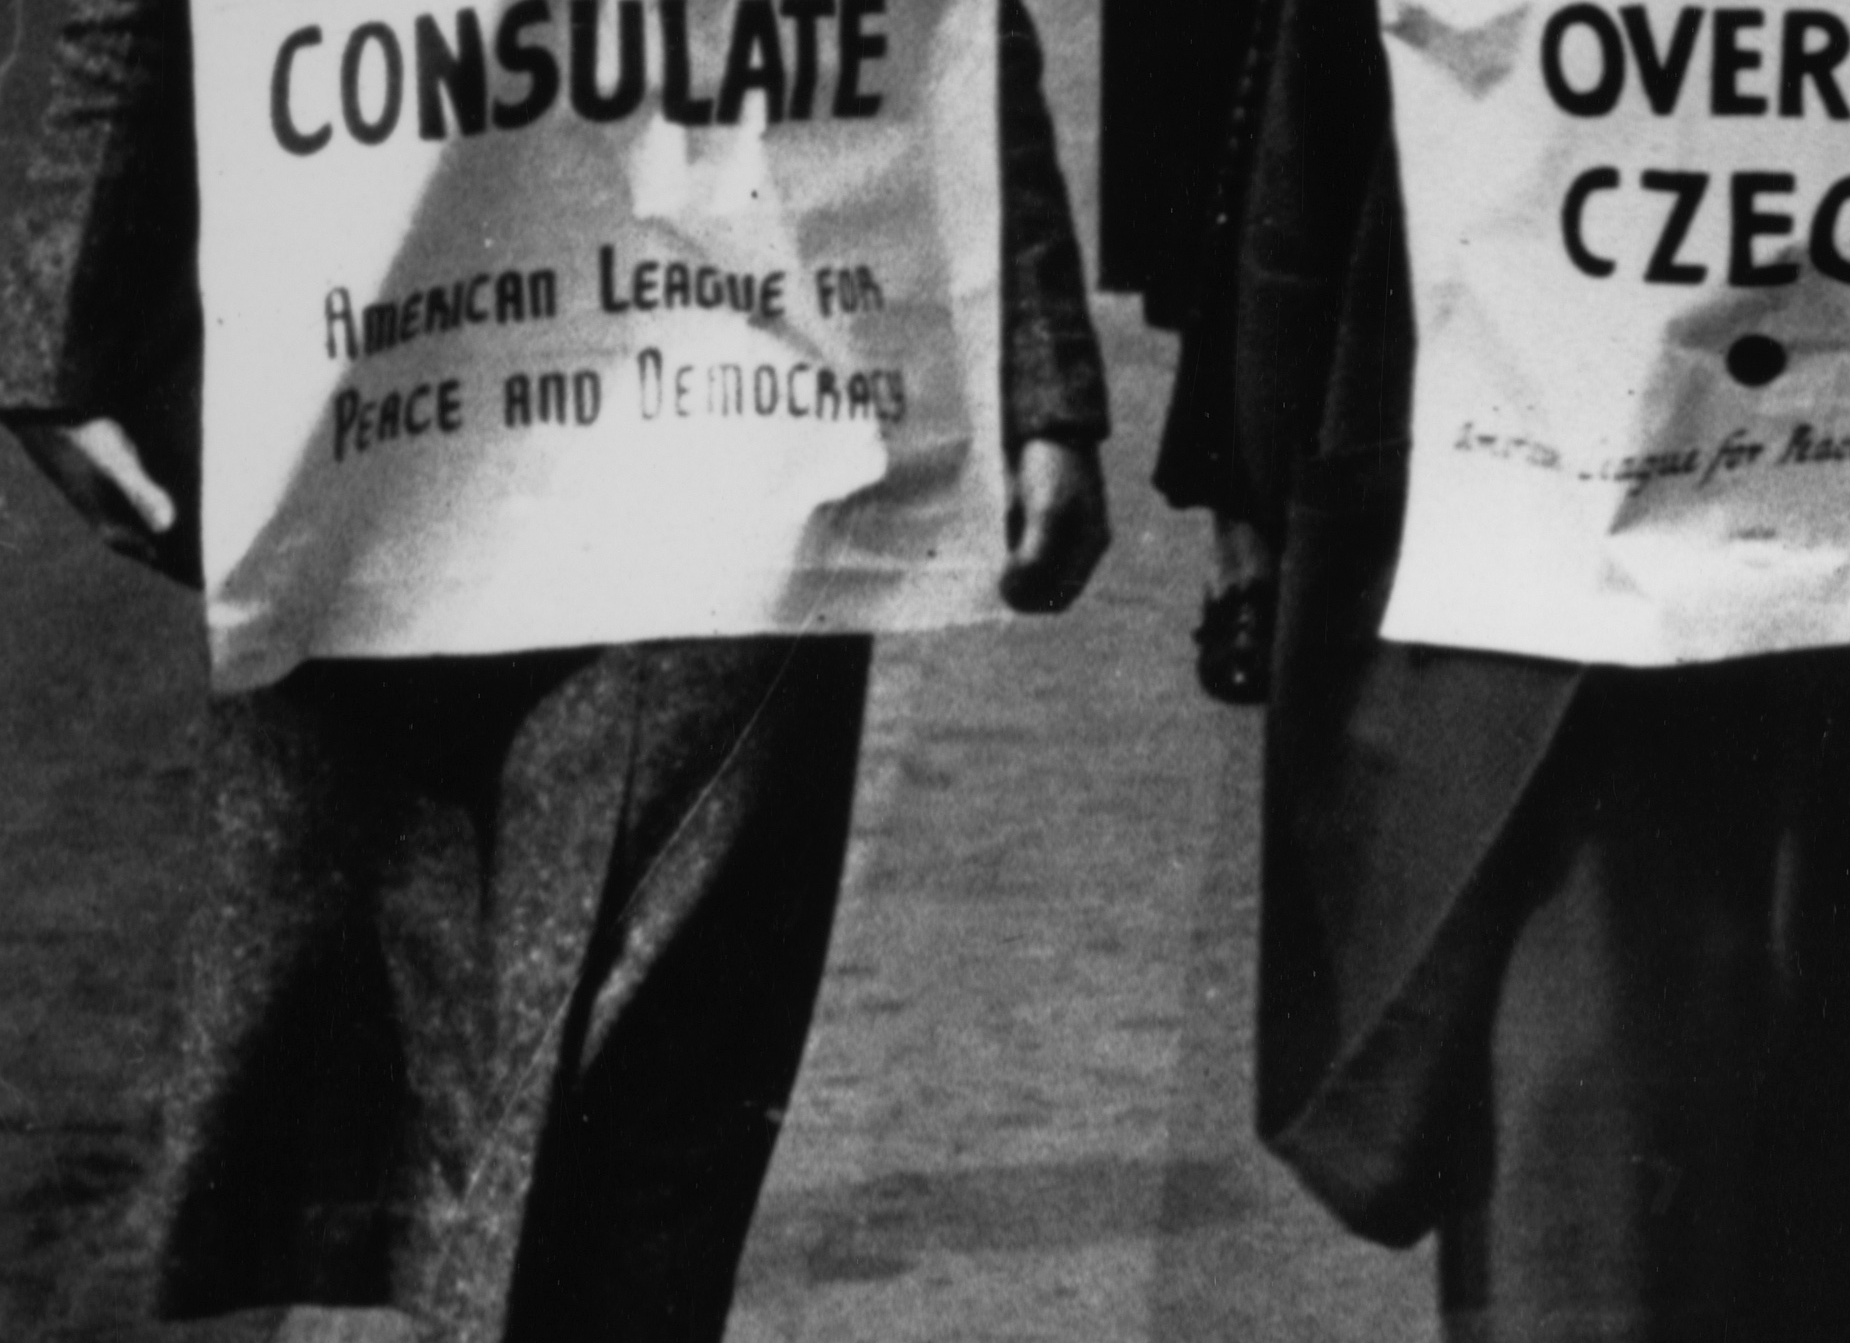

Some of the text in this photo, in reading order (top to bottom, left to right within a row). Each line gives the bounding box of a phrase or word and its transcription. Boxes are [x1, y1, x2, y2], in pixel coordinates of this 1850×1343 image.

[599, 244, 786, 318] LEAGUE
[814, 264, 886, 319] FOR
[331, 379, 463, 463] PEACE
[503, 369, 602, 430] AND
